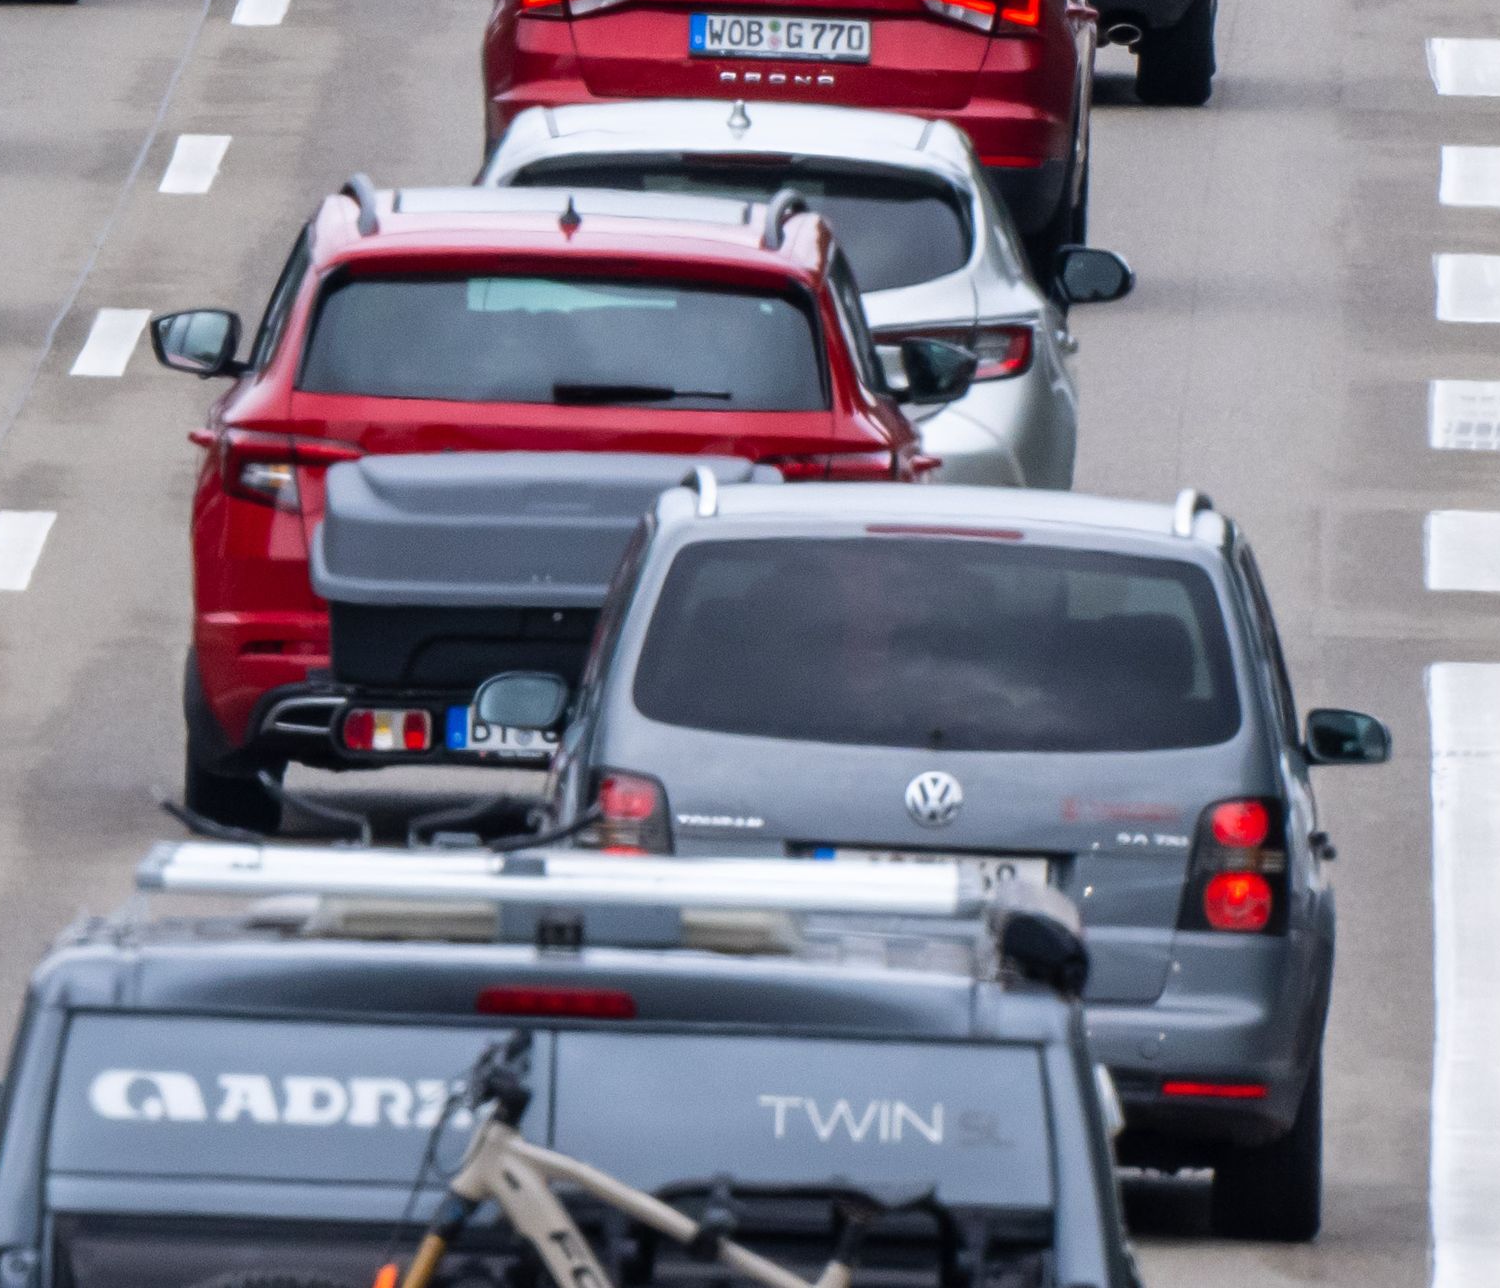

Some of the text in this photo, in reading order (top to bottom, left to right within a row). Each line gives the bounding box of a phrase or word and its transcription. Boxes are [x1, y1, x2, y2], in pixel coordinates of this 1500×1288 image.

[708, 21, 866, 51] WOB G 770
[757, 1093, 945, 1145] TWIN
